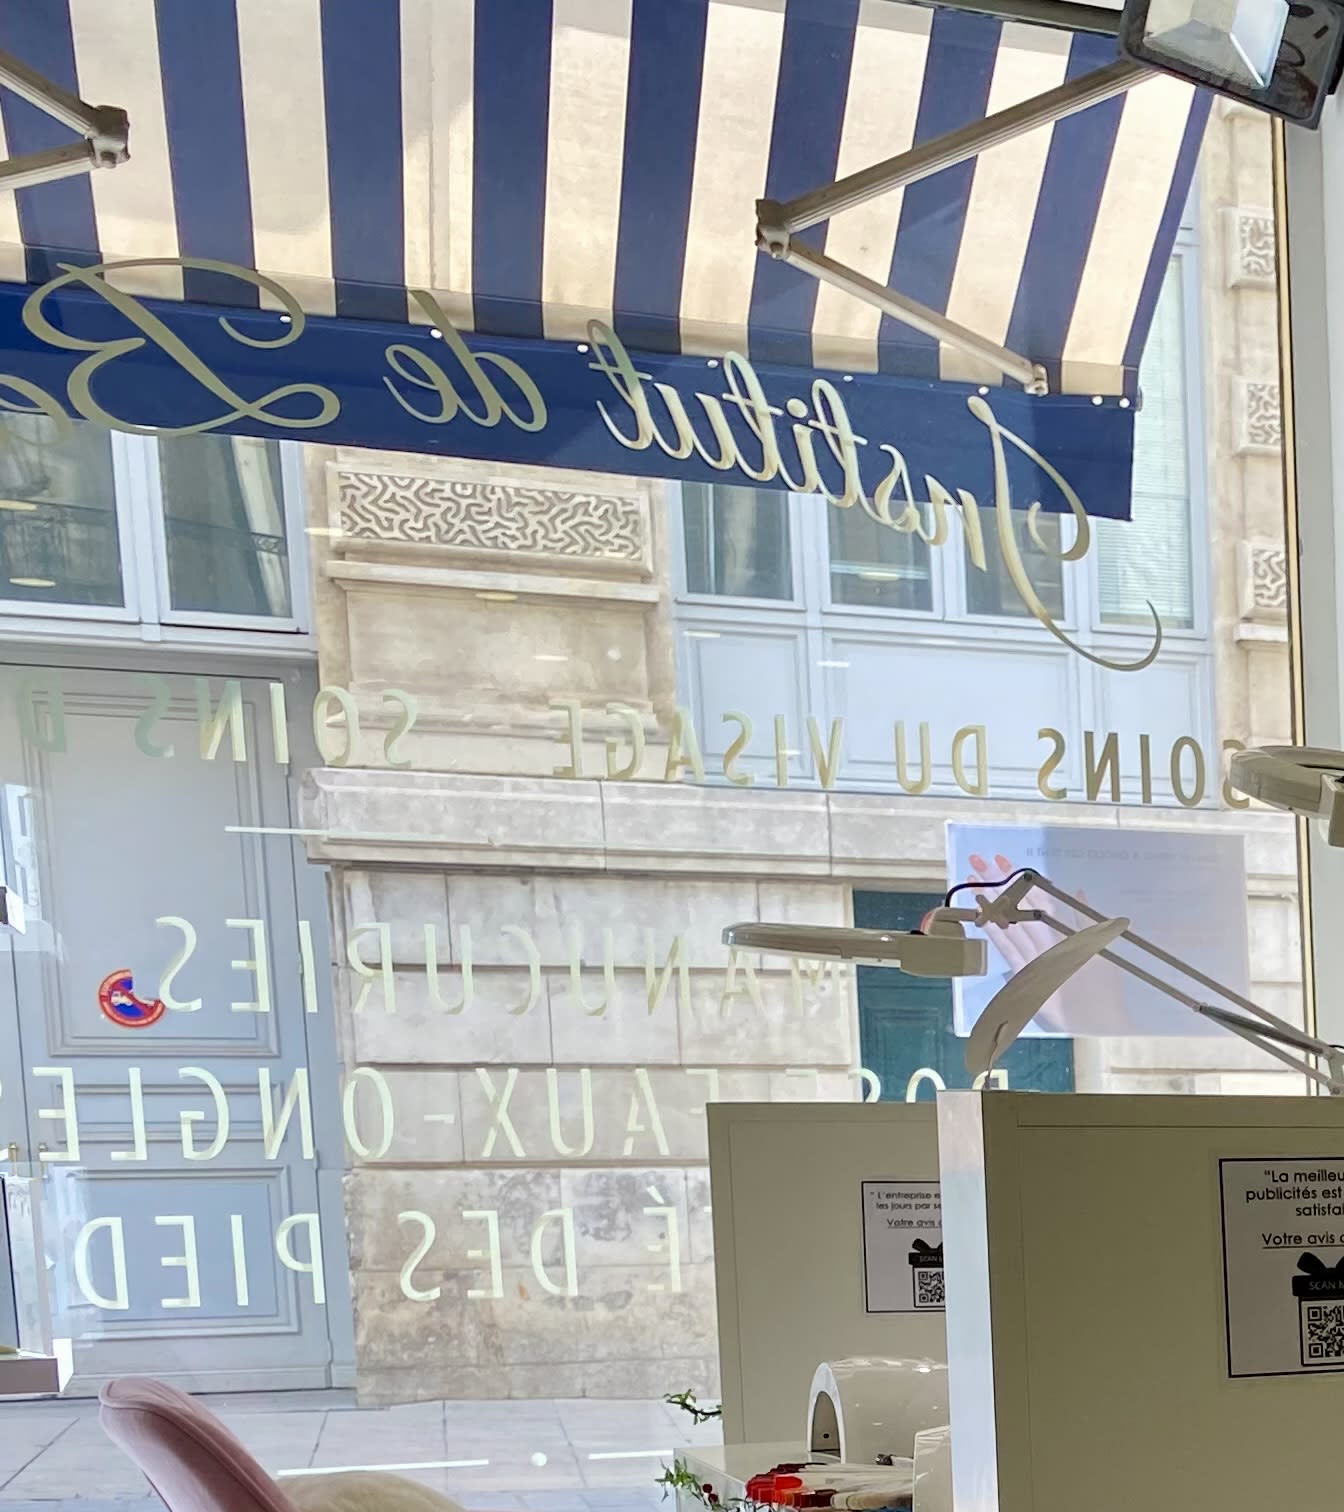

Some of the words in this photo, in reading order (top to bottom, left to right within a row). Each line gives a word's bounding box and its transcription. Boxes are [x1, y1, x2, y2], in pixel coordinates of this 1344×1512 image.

[1246, 1186, 1317, 1203] publicités
[1322, 1186, 1342, 1199] est
[1262, 1232, 1302, 1246] Votre
[1307, 1231, 1335, 1244] avis
[1309, 1280, 1336, 1290] SCAN
